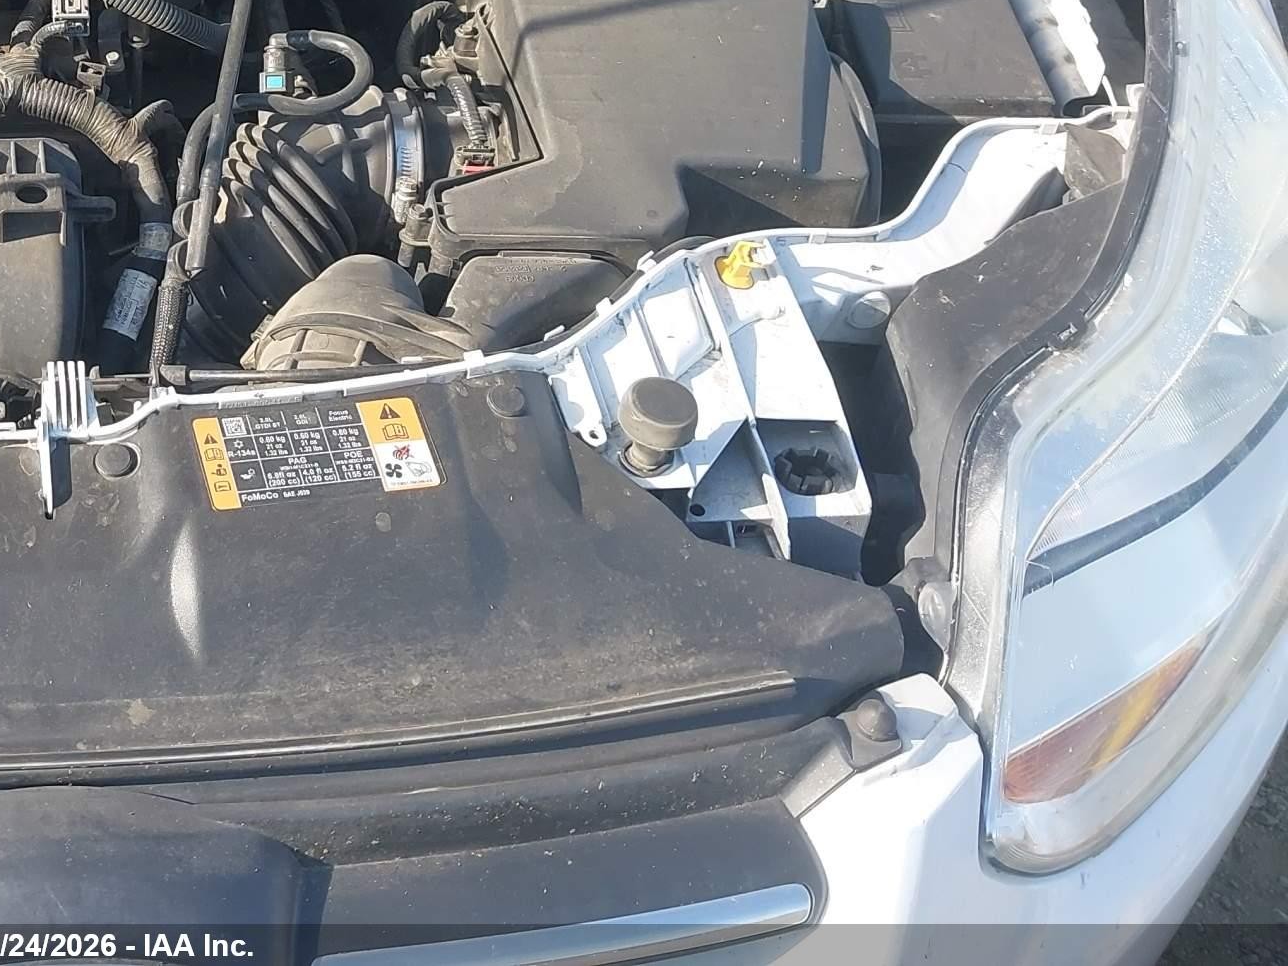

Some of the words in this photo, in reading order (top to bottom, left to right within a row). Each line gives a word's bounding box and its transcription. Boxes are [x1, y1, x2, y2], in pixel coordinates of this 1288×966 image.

[310, 431, 321, 439] kg
[349, 427, 359, 436] kg
[275, 435, 286, 443] kg
[227, 449, 256, 458] R-134a
[343, 450, 364, 459] POE
[288, 456, 308, 465] PAG
[363, 468, 376, 477] cc)
[287, 476, 301, 486] cc)
[305, 474, 322, 484] (120
[324, 473, 336, 482] cc)
[241, 490, 279, 502] FoMoCo
